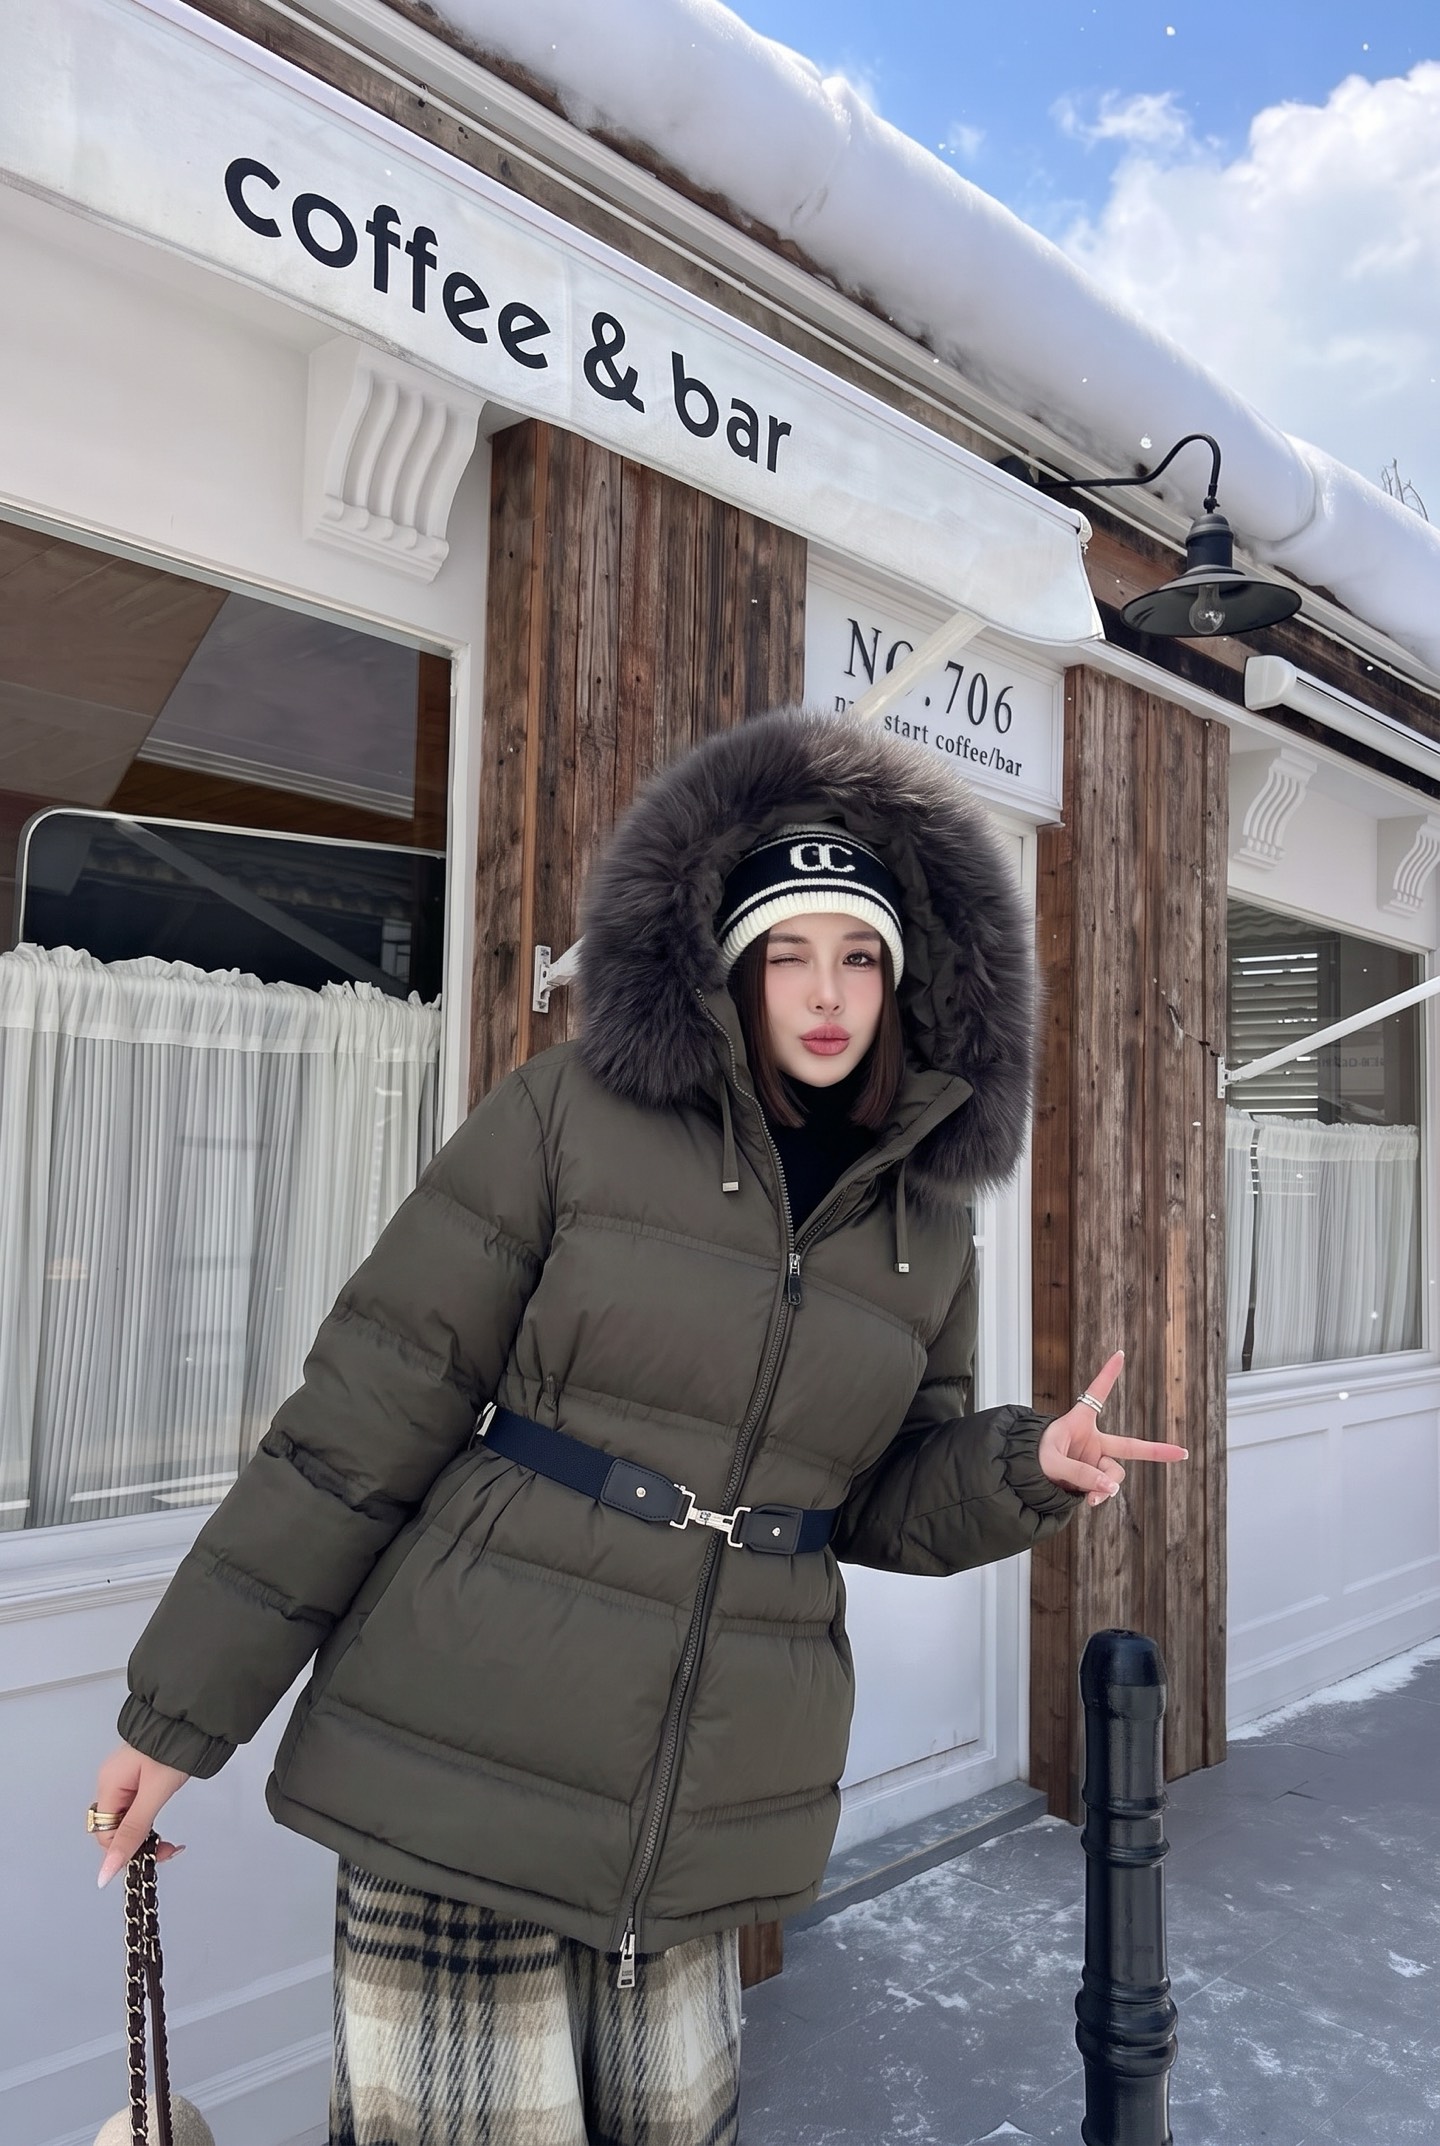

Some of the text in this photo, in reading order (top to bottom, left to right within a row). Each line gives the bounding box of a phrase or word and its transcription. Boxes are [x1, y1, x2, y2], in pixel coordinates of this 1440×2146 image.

[224, 157, 792, 474] coffee & bar
[883, 714, 1022, 777] start coffee/bar
